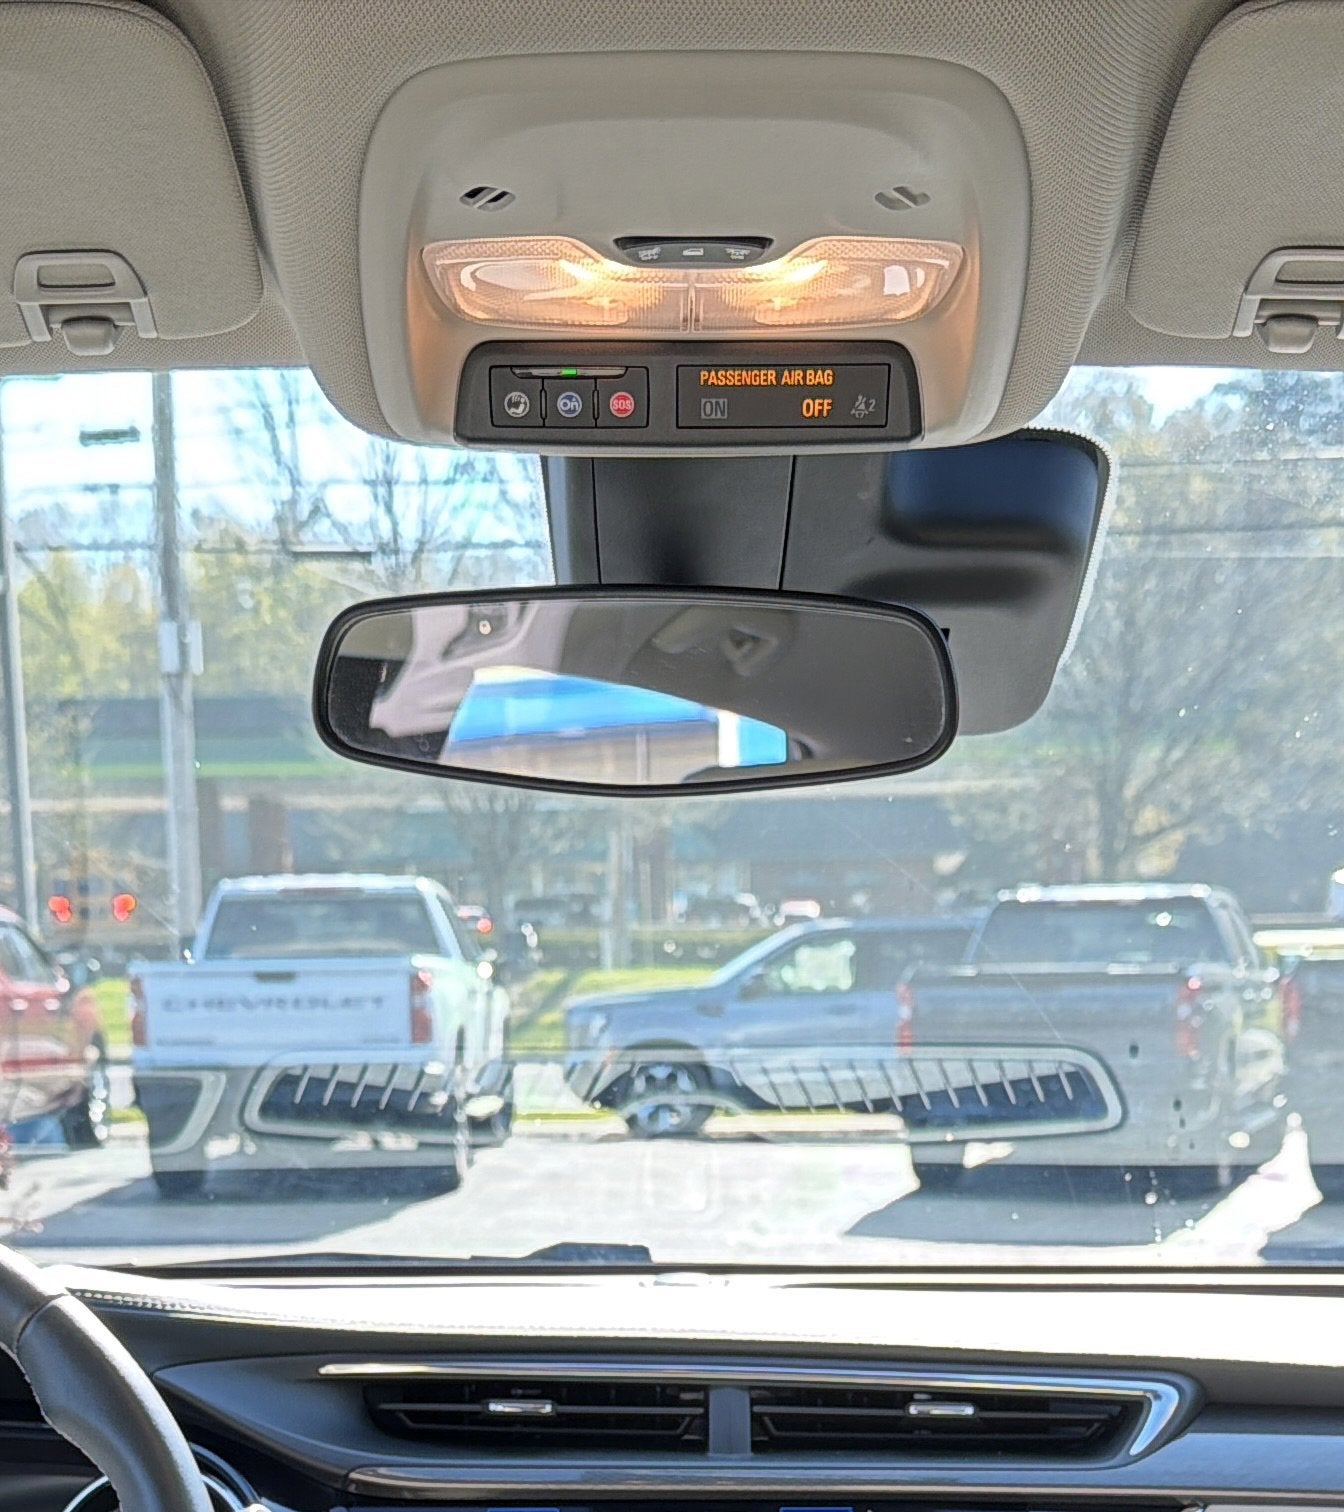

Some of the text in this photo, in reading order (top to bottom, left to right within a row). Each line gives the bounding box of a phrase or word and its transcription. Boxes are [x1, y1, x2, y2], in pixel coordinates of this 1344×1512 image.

[699, 370, 833, 386] PASSENGER AIR BAG
[612, 400, 633, 412] SOS
[703, 400, 727, 418] ON
[802, 399, 832, 418] OFF
